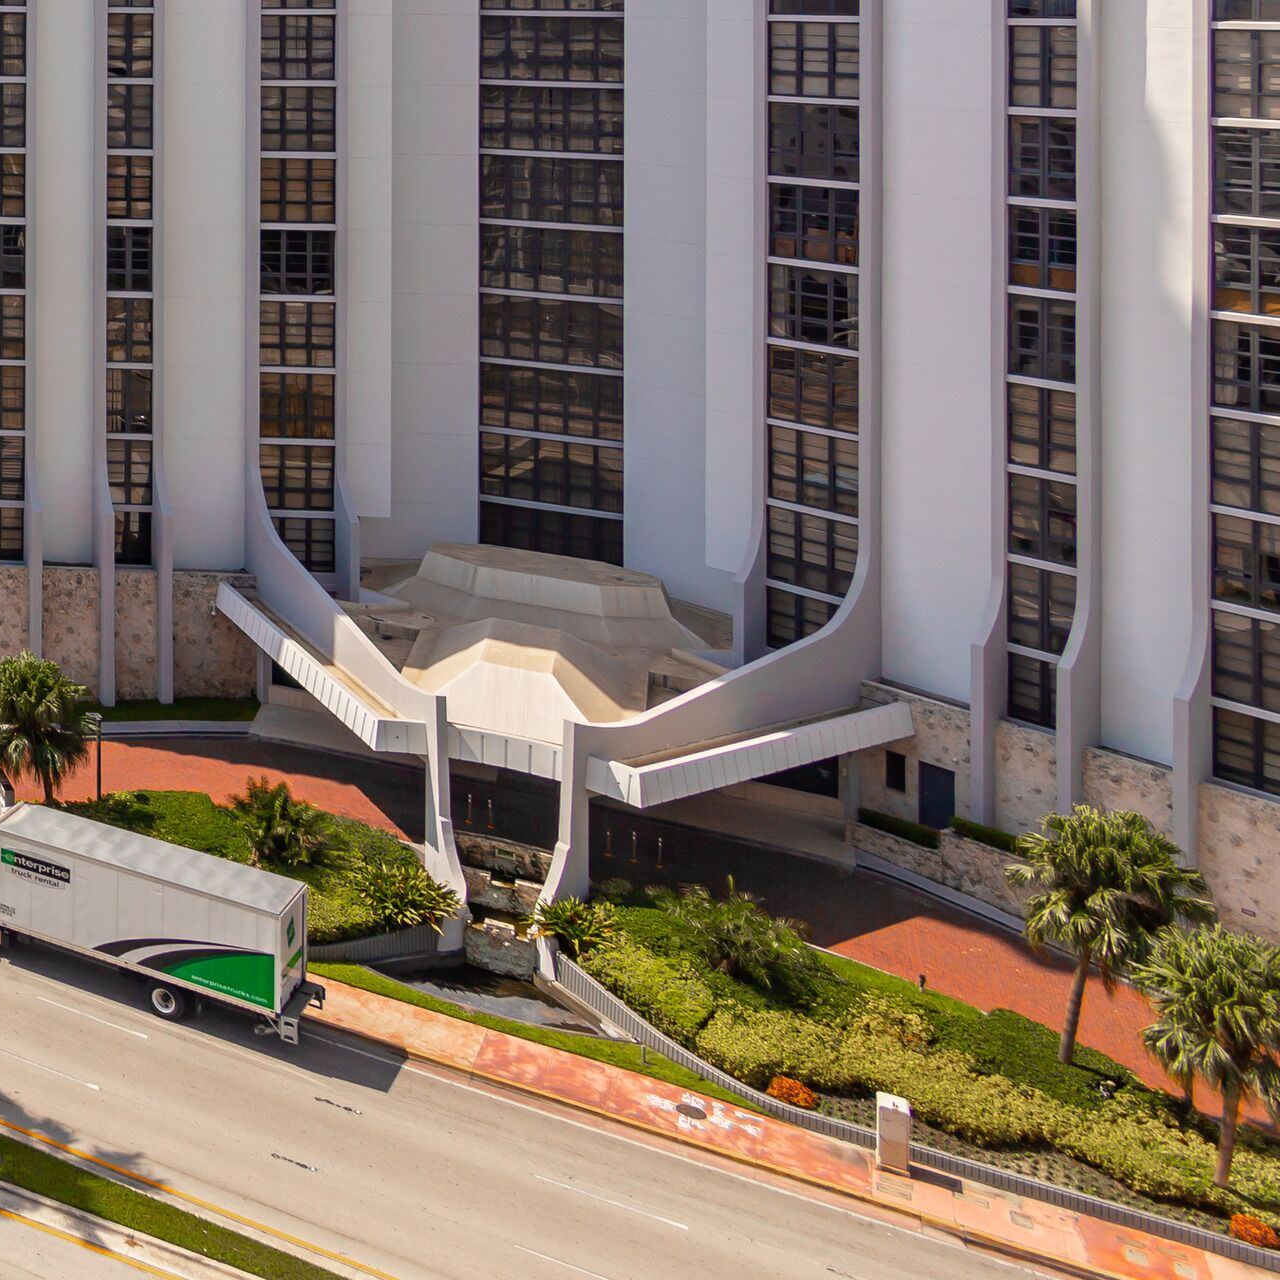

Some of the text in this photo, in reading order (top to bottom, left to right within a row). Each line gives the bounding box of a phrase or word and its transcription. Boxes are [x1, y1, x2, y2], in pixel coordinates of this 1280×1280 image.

[1, 853, 69, 879] enterprise
[11, 868, 60, 888] truck rental
[191, 975, 268, 1004] enterprisetrucks.com
